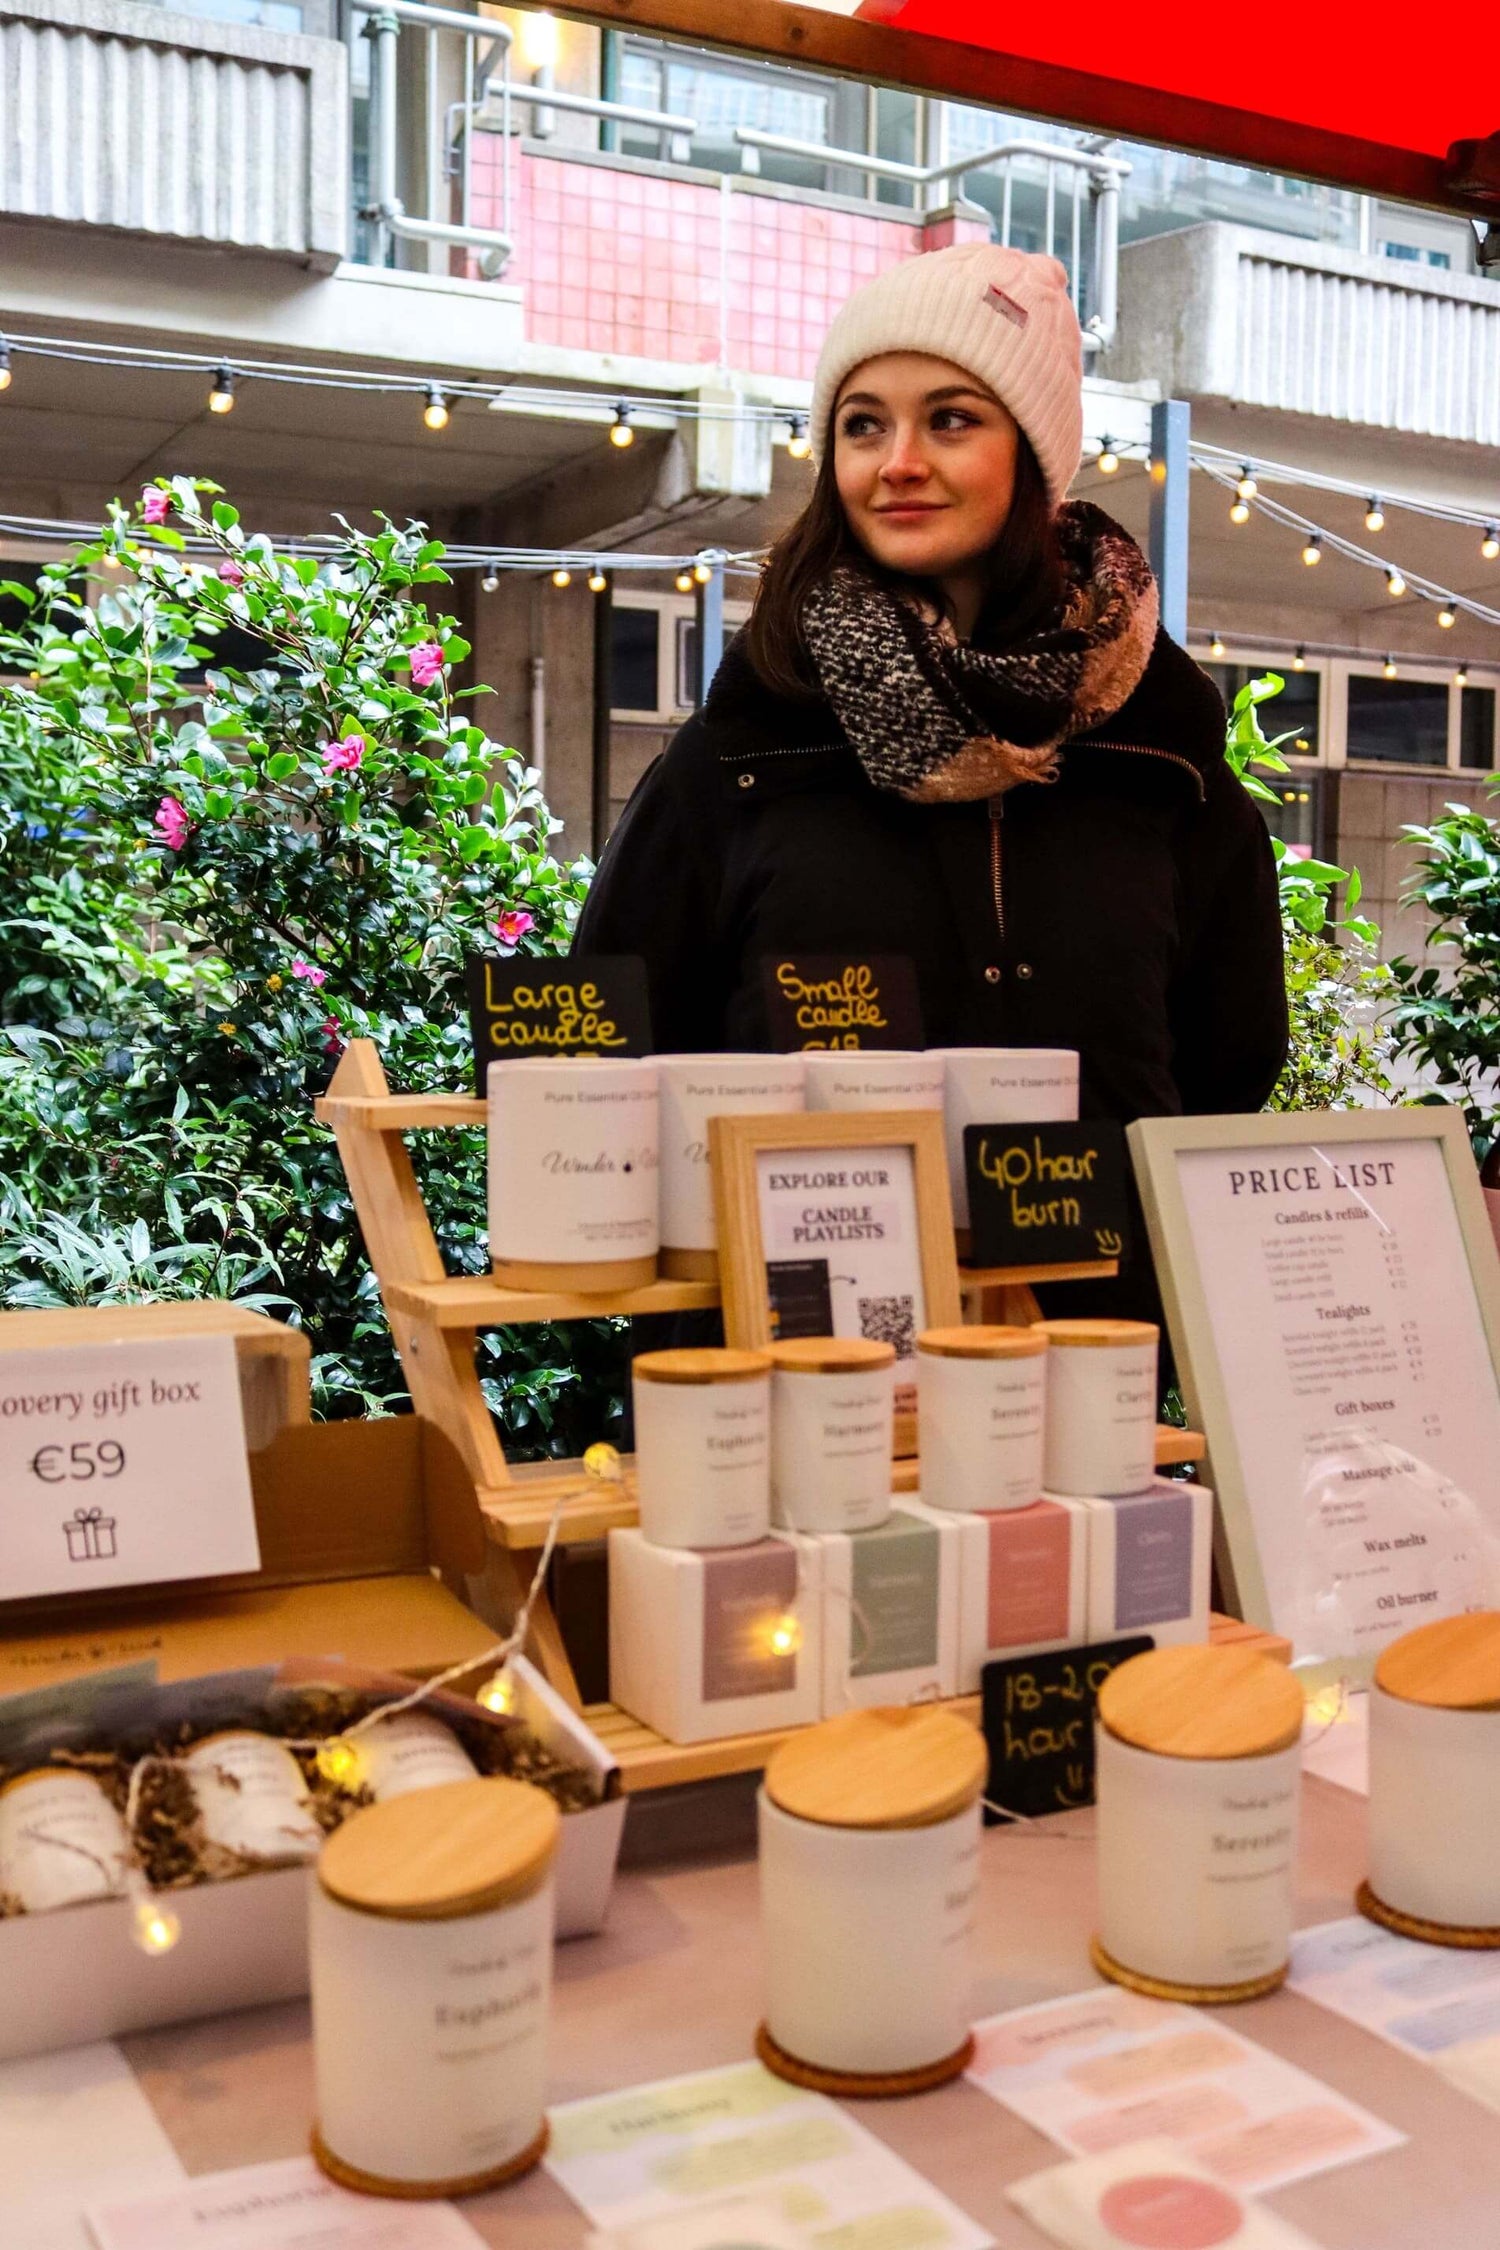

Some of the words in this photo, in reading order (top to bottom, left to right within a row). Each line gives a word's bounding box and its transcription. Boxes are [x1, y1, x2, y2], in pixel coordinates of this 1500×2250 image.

[484, 962, 605, 1016] Large
[776, 962, 879, 1003] Small
[797, 999, 888, 1029] candle
[490, 1012, 628, 1047] candle
[978, 1139, 1032, 1190] 40
[769, 1172, 848, 1191] EXPLORE
[851, 1170, 890, 1187] OUR
[1229, 1166, 1321, 1195] PRICE
[1333, 1162, 1396, 1189] LIST
[802, 1206, 873, 1224] CANDLE
[1010, 1187, 1081, 1229] burn
[1274, 1210, 1322, 1226] Candles
[1323, 1209, 1334, 1222] &
[1335, 1206, 1370, 1221] refills
[792, 1223, 885, 1244] PLAYLISTS
[1316, 1304, 1371, 1322] Tealights
[92, 1379, 141, 1419] gift
[150, 1378, 201, 1406] box
[1334, 1400, 1359, 1417] Gift
[1359, 1400, 1396, 1414] boxes
[27, 1439, 126, 1484] €59
[1341, 1465, 1393, 1482] Massage
[1363, 1540, 1392, 1553] Wax
[1393, 1533, 1428, 1549] melts
[1376, 1595, 1396, 1611] Oil
[1396, 1589, 1439, 1607] burner
